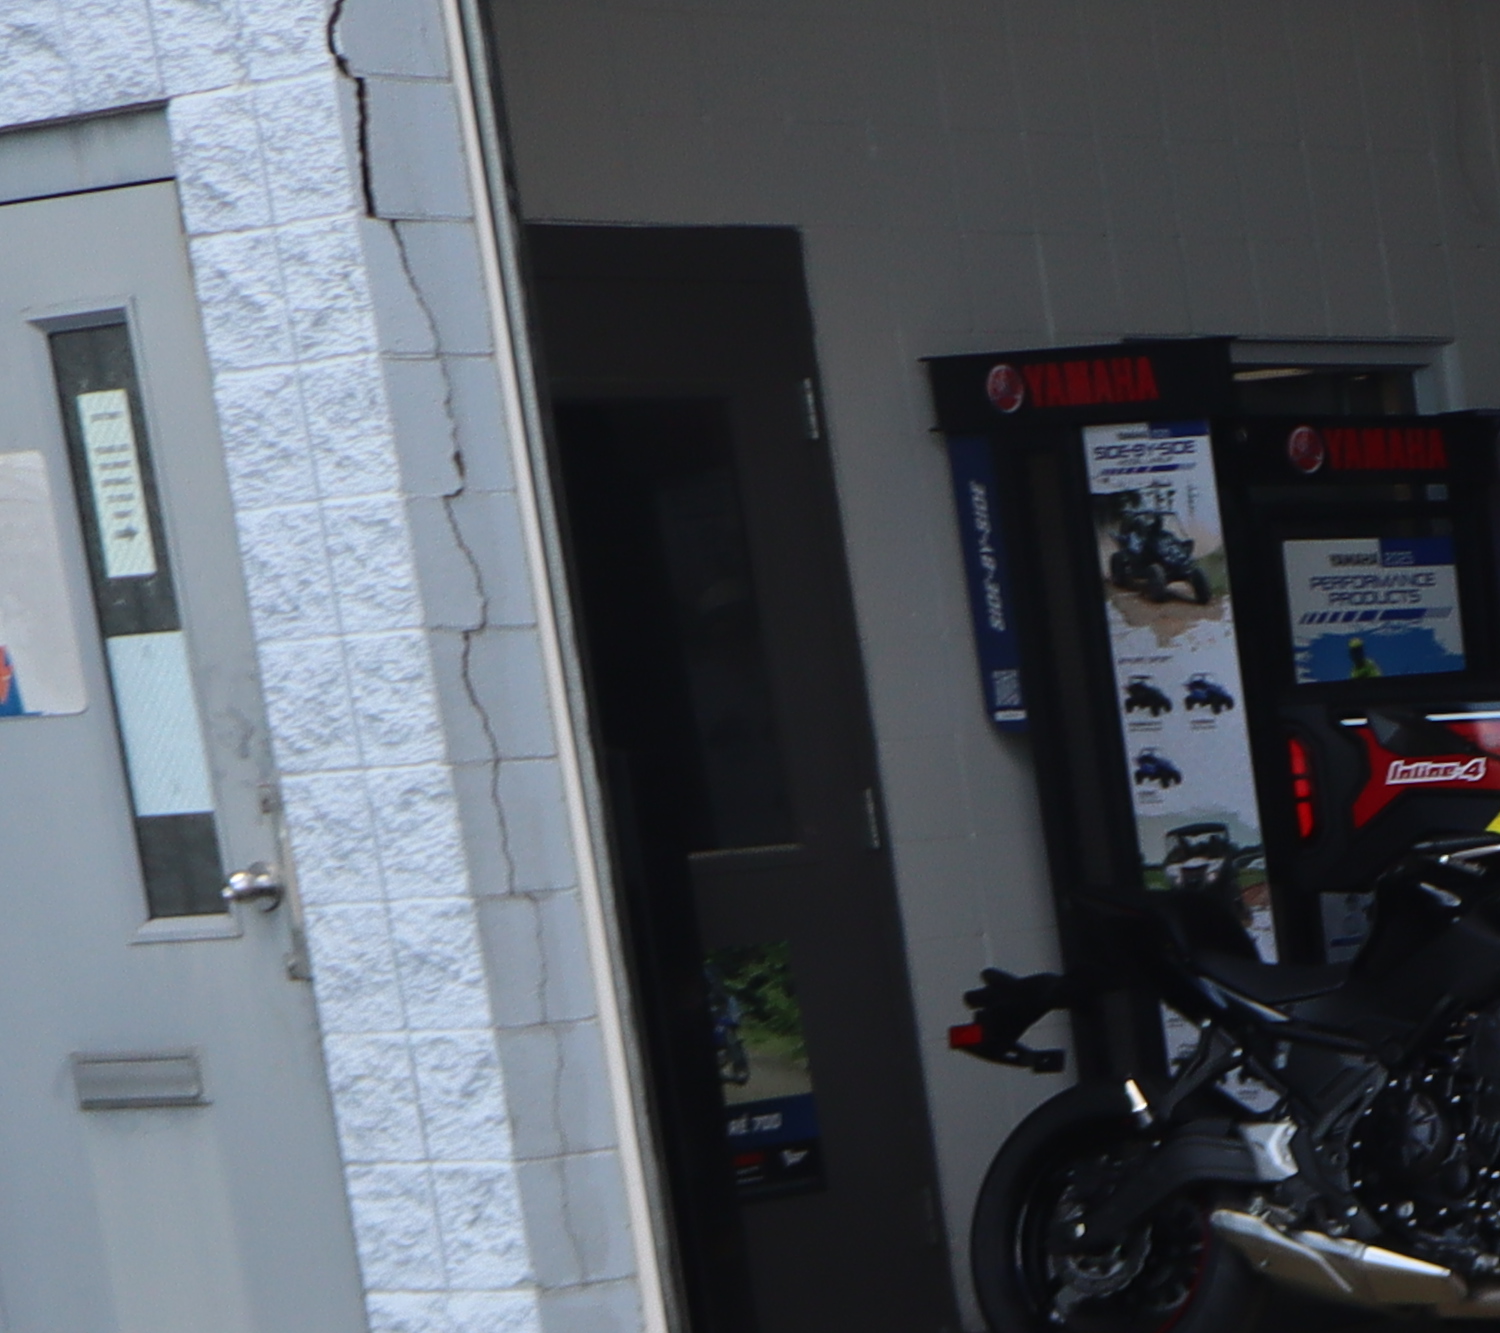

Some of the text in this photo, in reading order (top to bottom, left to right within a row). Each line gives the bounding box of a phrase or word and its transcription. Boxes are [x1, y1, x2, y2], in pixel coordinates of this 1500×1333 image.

[1022, 357, 1160, 407] YAMAHA
[1321, 426, 1450, 471] YAMAHA
[1308, 571, 1437, 591] PERFORMANCE
[1328, 588, 1423, 606] PRODUCTS
